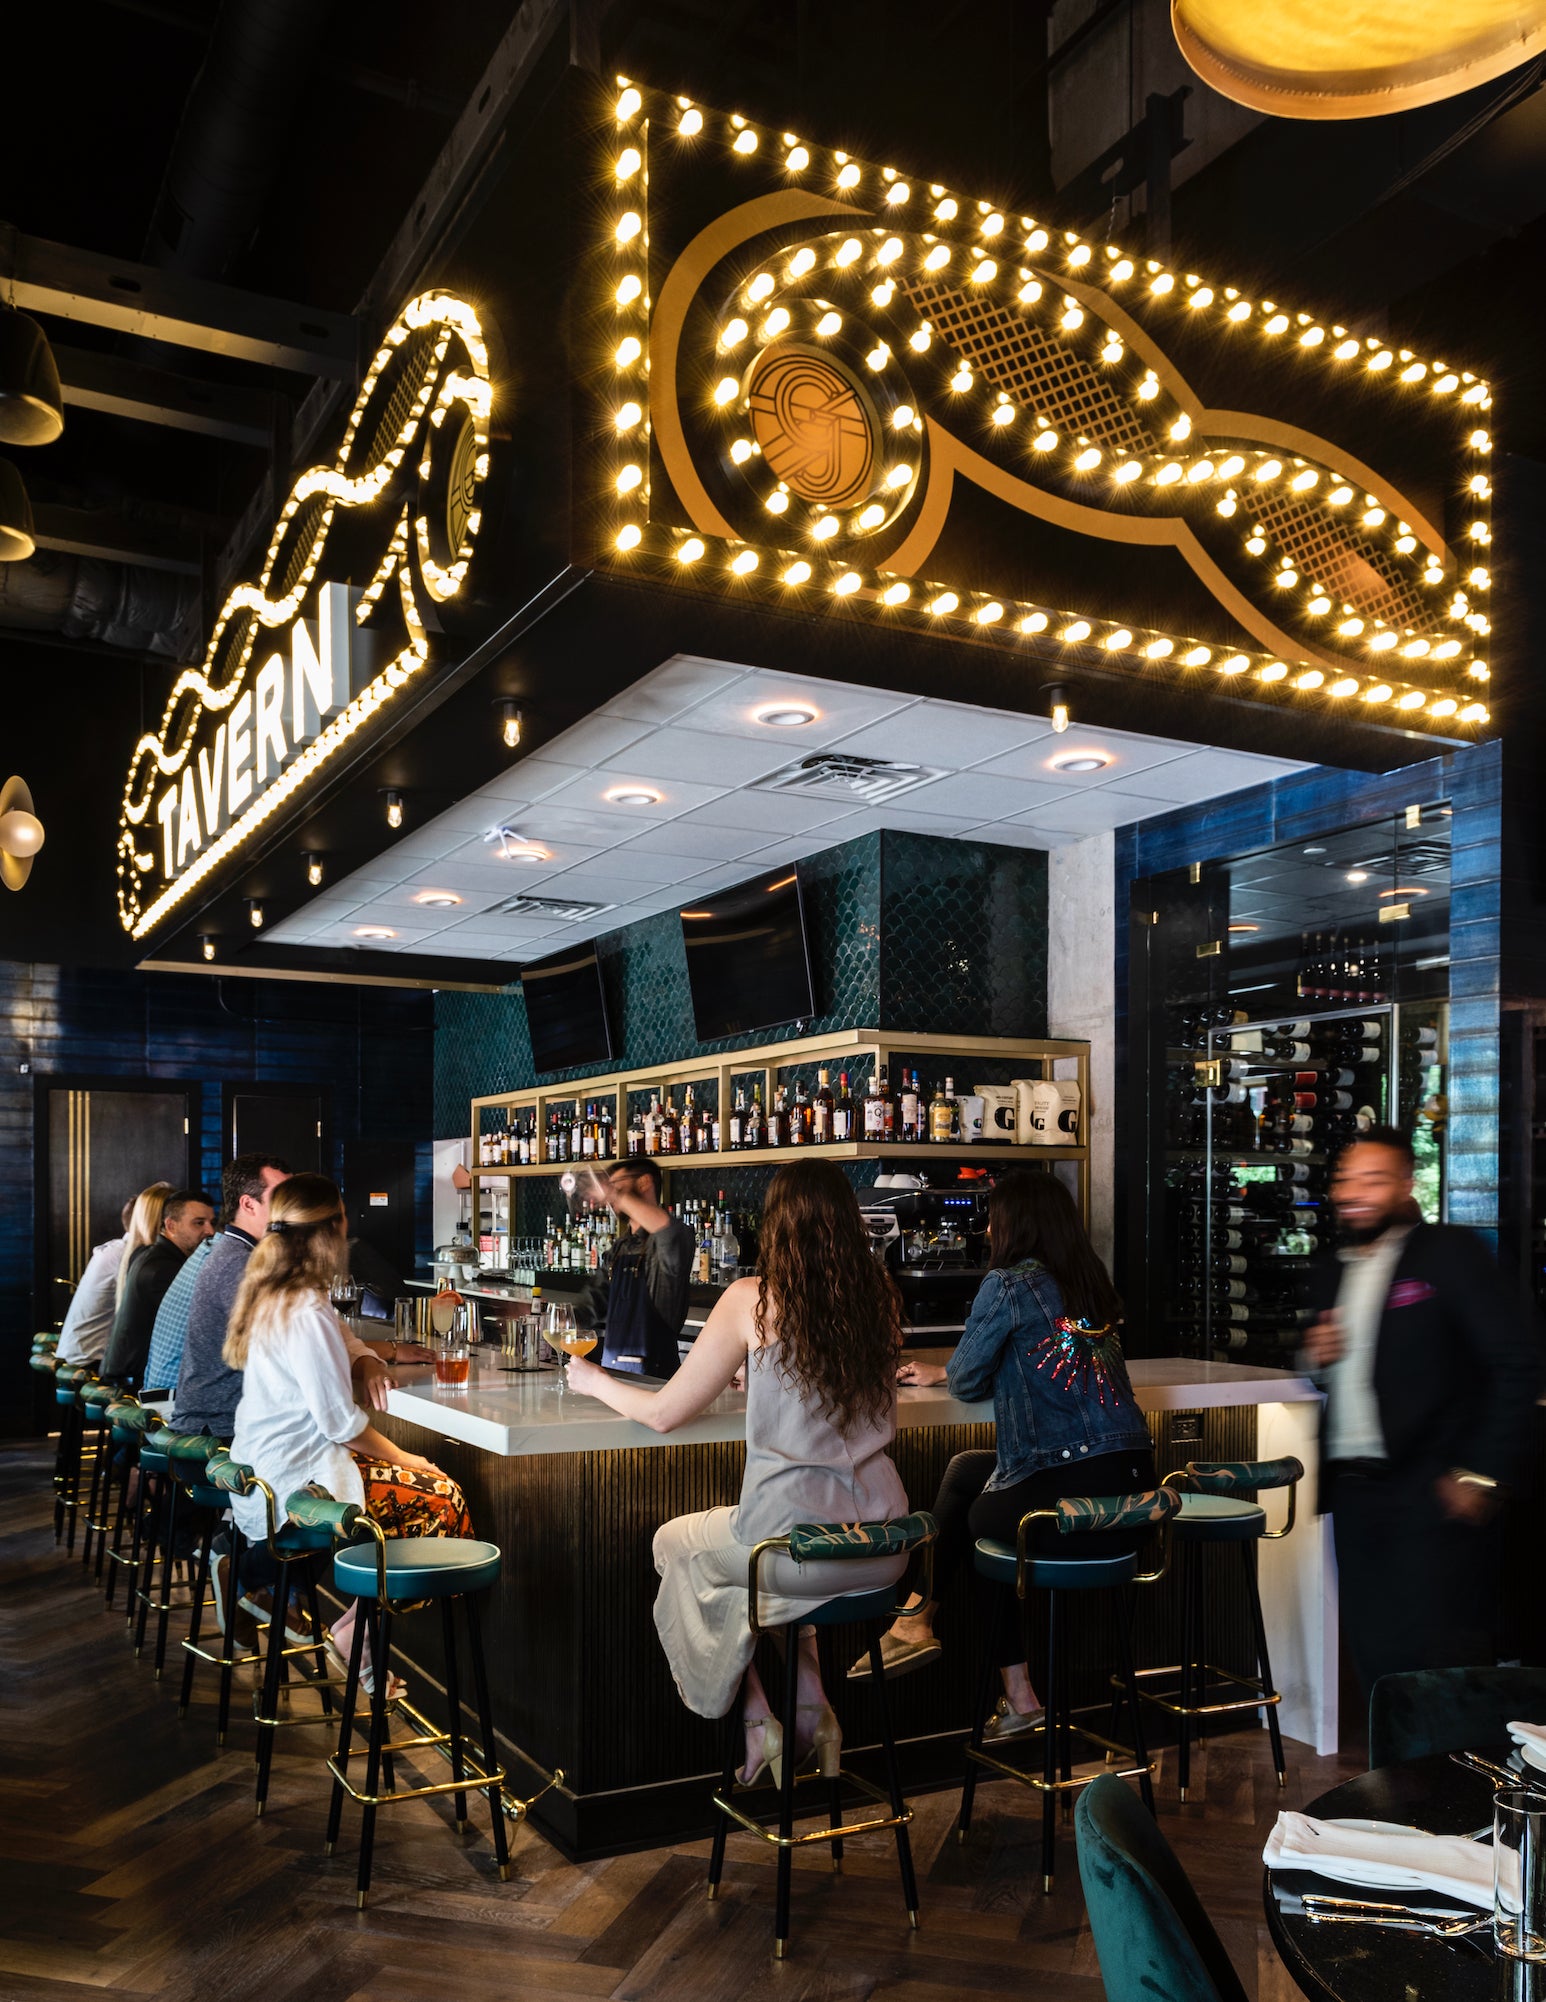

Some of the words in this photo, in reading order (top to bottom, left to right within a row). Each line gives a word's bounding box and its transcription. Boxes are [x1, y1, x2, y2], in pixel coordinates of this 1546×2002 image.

[158, 581, 334, 880] TAVERN
[994, 1107, 1015, 1130] G
[1034, 1118, 1045, 1130] G
[1058, 1110, 1077, 1132] G
